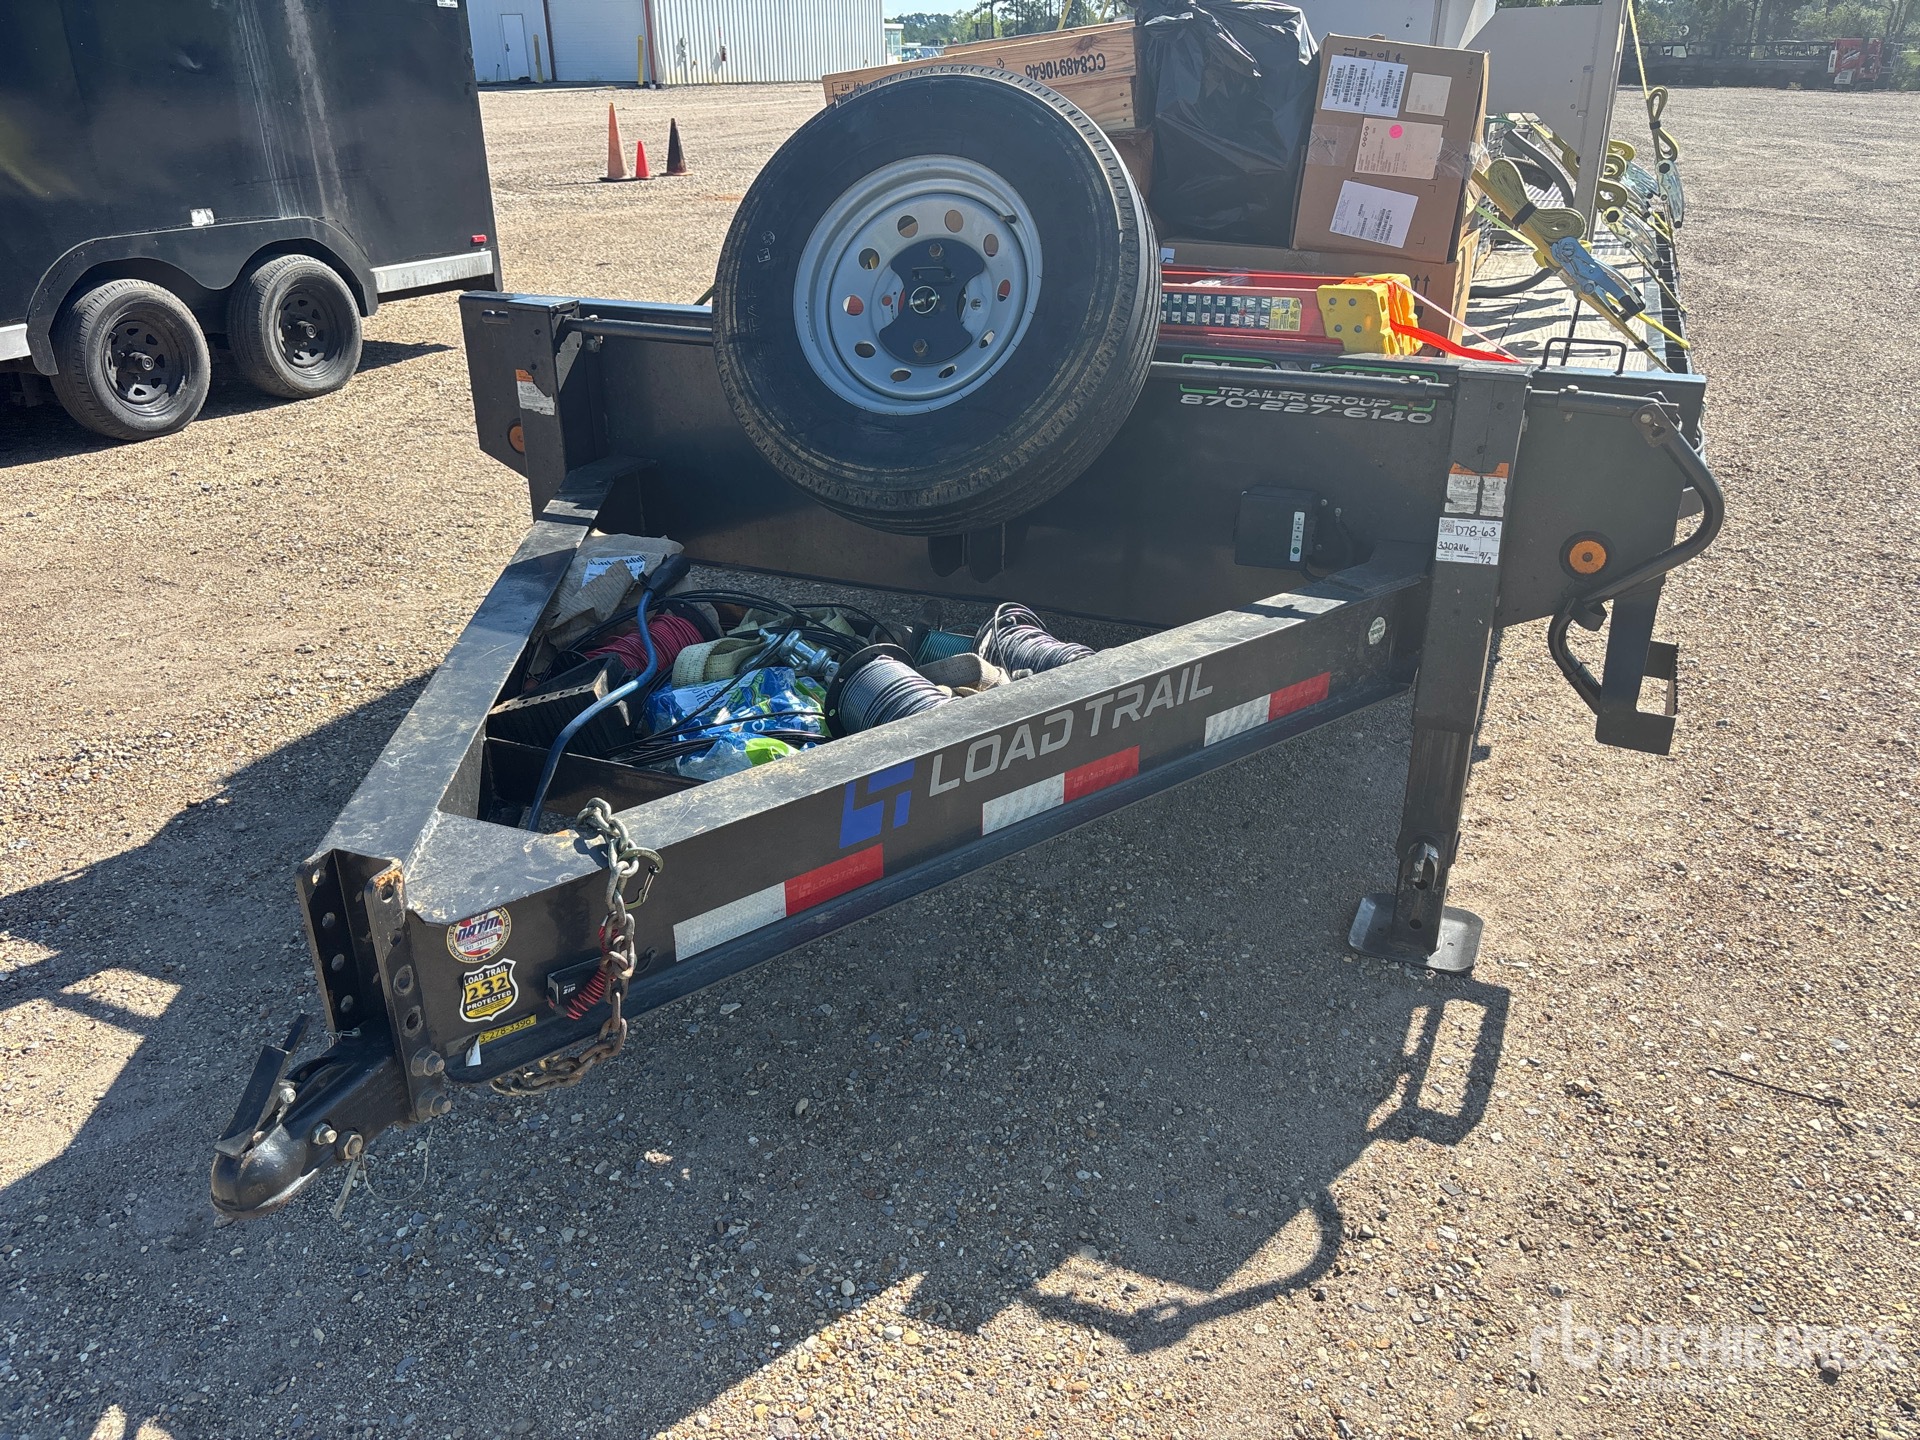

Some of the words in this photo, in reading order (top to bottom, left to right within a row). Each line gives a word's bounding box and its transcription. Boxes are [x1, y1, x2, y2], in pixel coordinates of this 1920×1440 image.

[1025, 53, 1106, 80] CC848910646
[1218, 386, 1307, 402] TRAILER
[1310, 394, 1391, 408] GROUP
[1180, 394, 1432, 424] 870-227-6140
[1455, 525, 1497, 537] D78-63
[928, 709, 1074, 797] LOAD
[1085, 663, 1213, 737] TRAIL
[464, 973, 484, 986] LOAD
[486, 964, 508, 978] TRAIL
[466, 990, 512, 1011] PROTECTED
[468, 977, 507, 1001] 232
